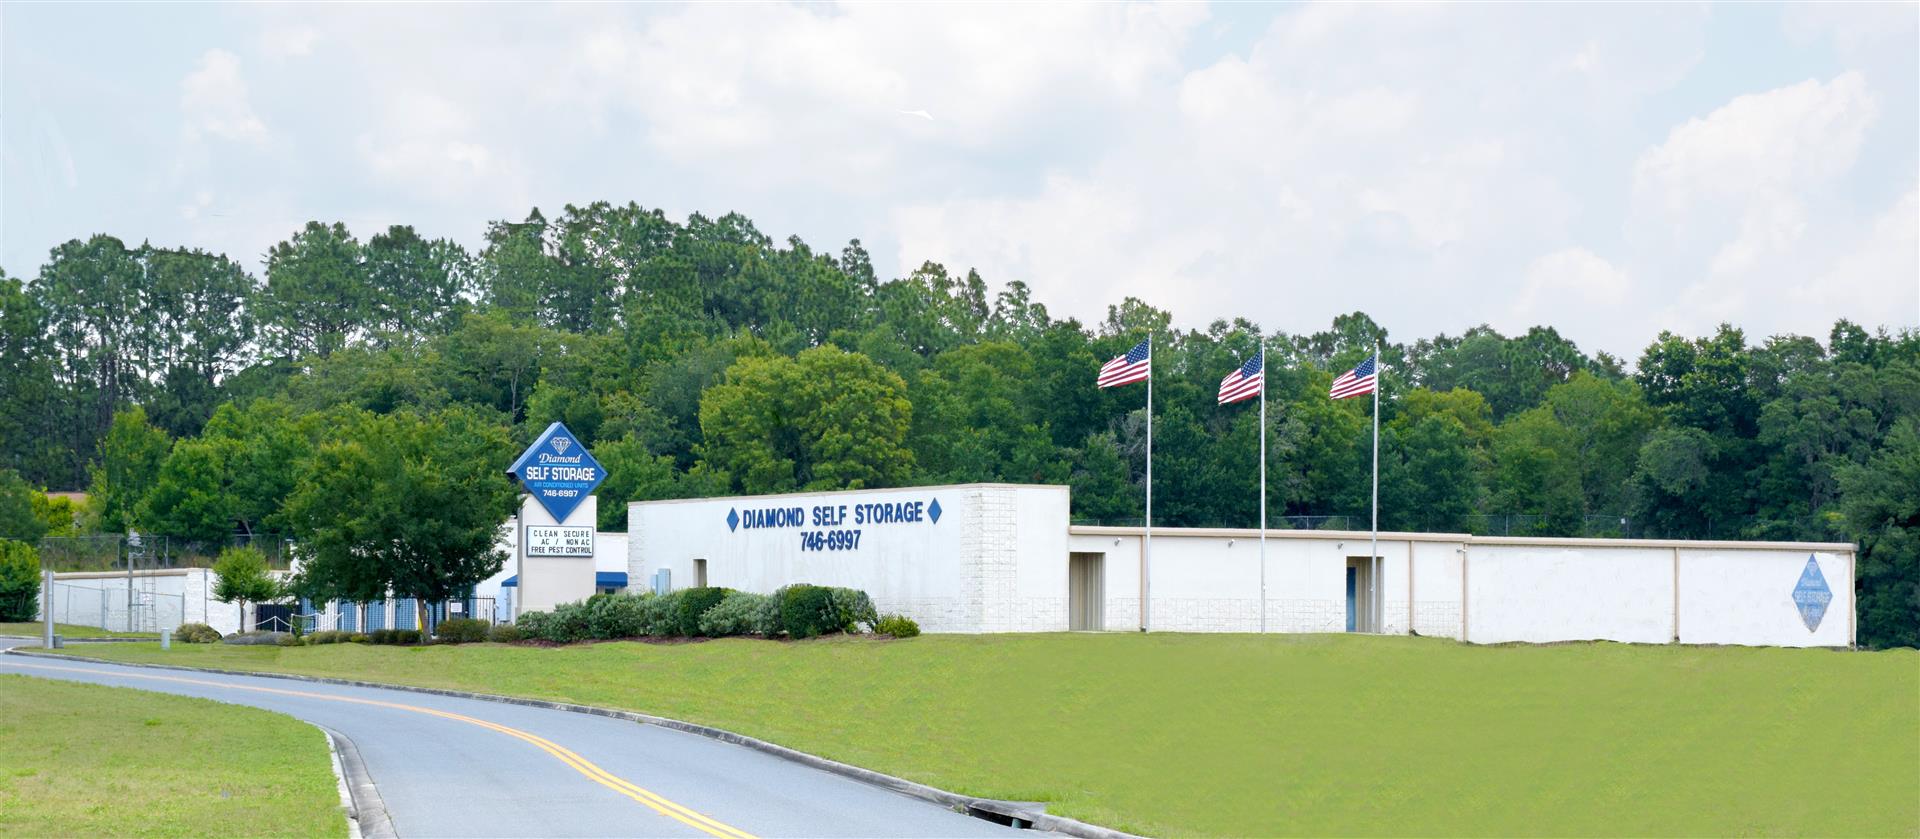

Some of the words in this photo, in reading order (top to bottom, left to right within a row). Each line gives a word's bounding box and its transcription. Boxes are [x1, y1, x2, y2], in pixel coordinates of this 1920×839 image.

[539, 453, 582, 464] Diamond
[526, 466, 550, 480] SELF
[552, 467, 595, 481] STORAGE
[543, 481, 573, 489] CONDITIONED
[543, 489, 578, 497] 746-6997
[742, 506, 805, 529] DIAMOND
[812, 505, 847, 527] SELF
[855, 501, 924, 525] STORAGE
[533, 530, 559, 538] CLEAN
[564, 530, 590, 538] SECURE
[541, 538, 550, 546] AC
[566, 538, 579, 546] NON
[800, 529, 861, 552] 746-6997
[531, 546, 545, 554] FREE
[548, 546, 564, 554] PEST
[565, 546, 592, 554] CONTROL
